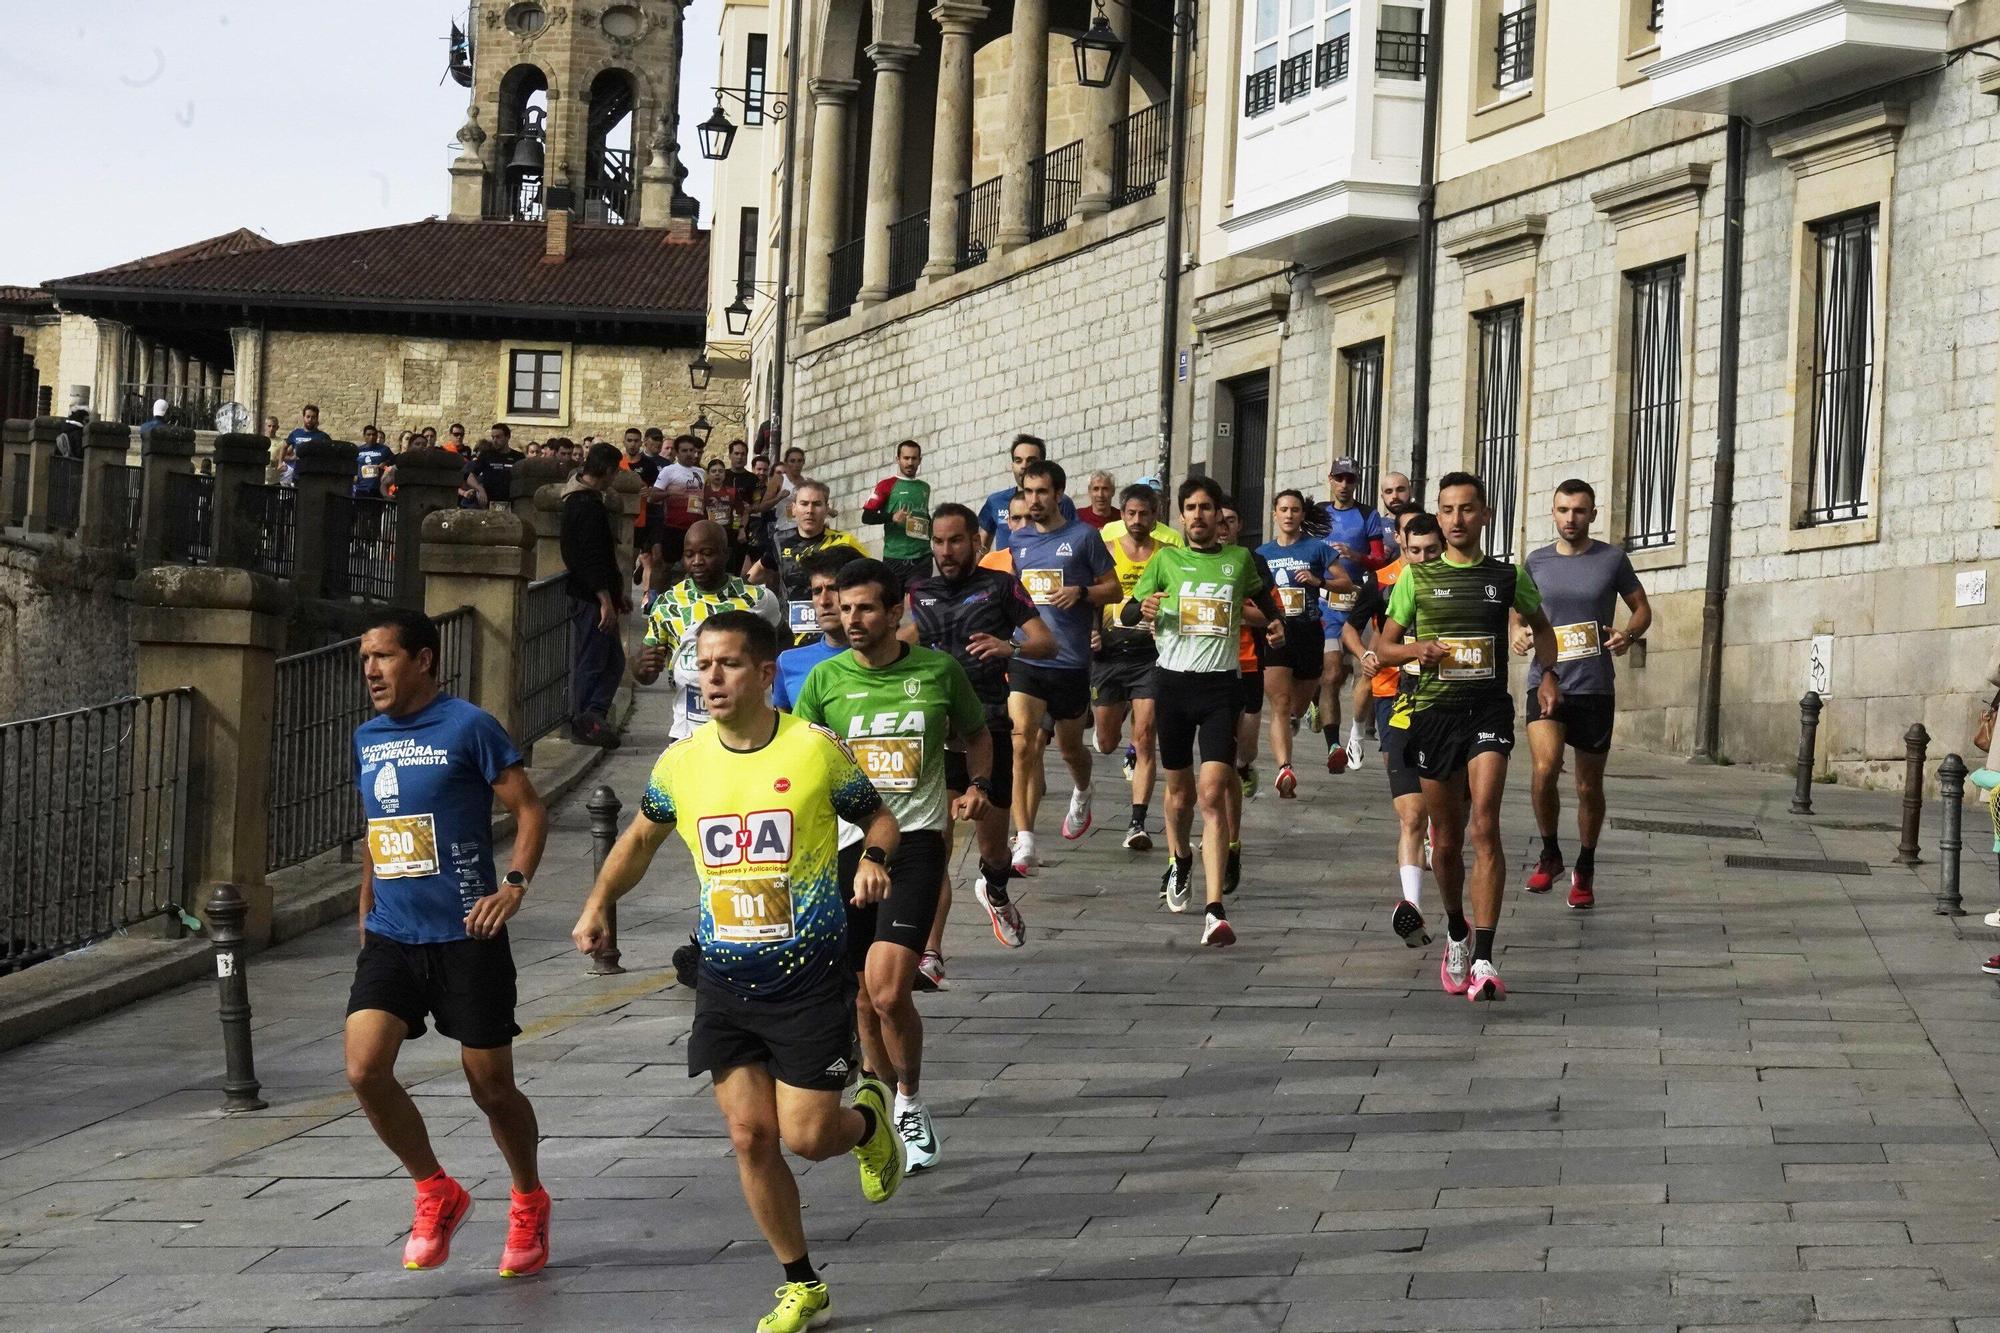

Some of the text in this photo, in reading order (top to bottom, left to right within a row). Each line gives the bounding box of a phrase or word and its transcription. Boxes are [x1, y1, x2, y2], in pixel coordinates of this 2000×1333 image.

[1180, 582, 1233, 600] LEA
[1197, 607, 1215, 622] 58
[1563, 631, 1587, 648] 333
[1455, 648, 1482, 664] 446
[848, 711, 925, 738] LEA
[369, 745, 435, 764] ALMENDRA
[397, 756, 449, 767] KONKISTA
[867, 752, 904, 772] 520
[379, 831, 414, 856] 330
[730, 894, 765, 918] 101
